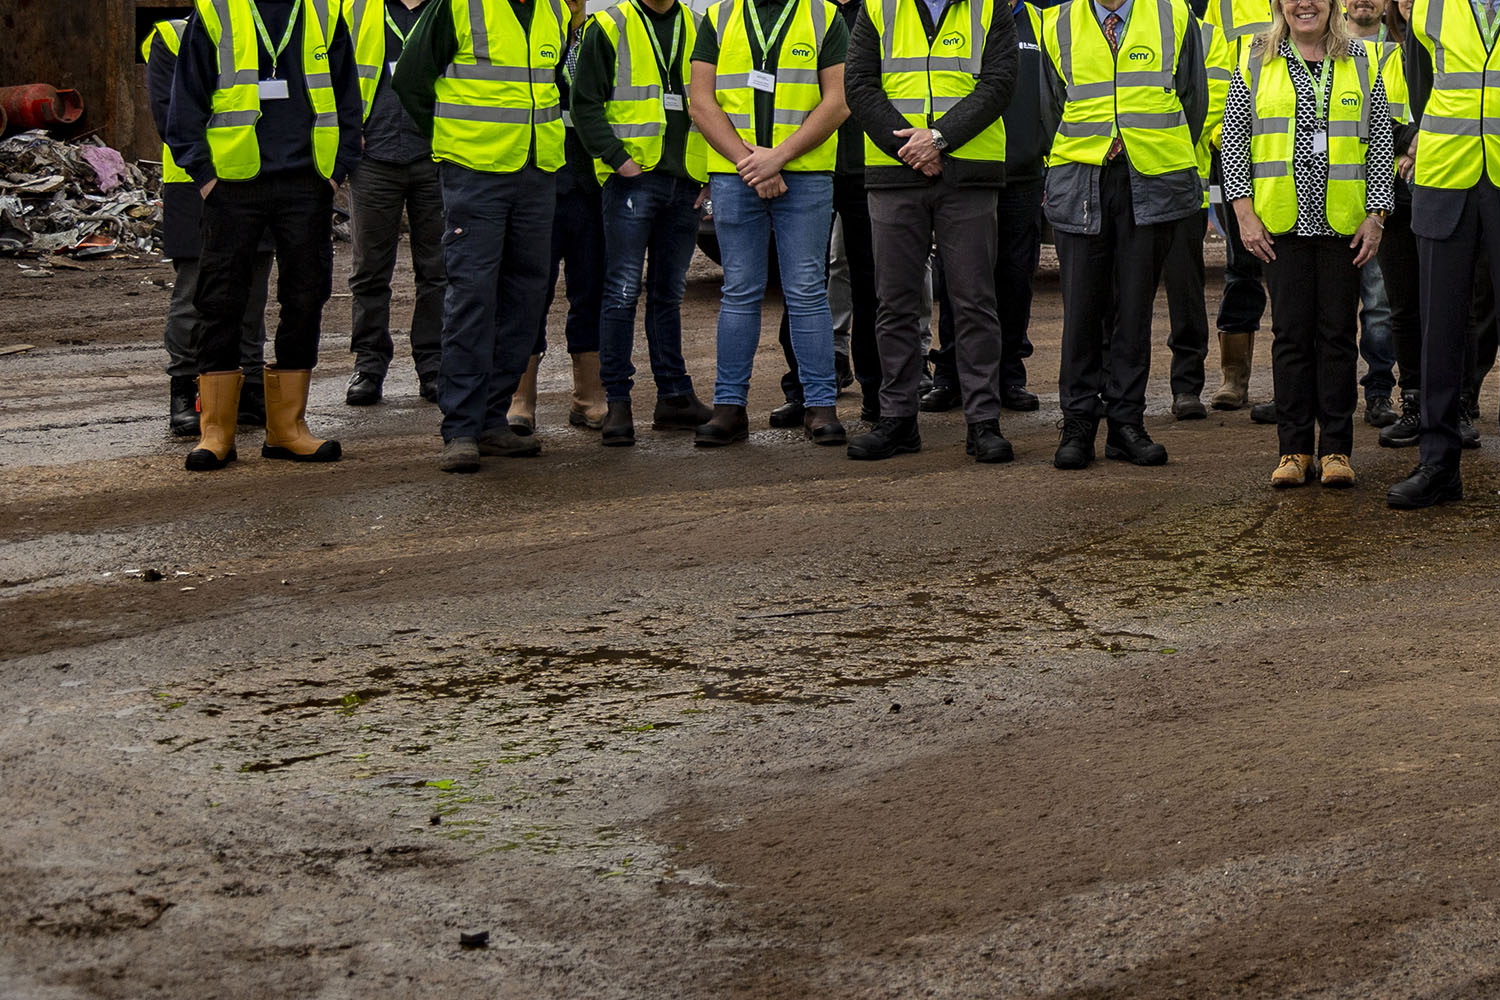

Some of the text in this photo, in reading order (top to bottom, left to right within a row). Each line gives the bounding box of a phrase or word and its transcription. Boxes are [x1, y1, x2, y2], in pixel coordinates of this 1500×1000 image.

[942, 37, 960, 46] emr
[791, 49, 810, 57] emr
[1129, 52, 1149, 61] emr
